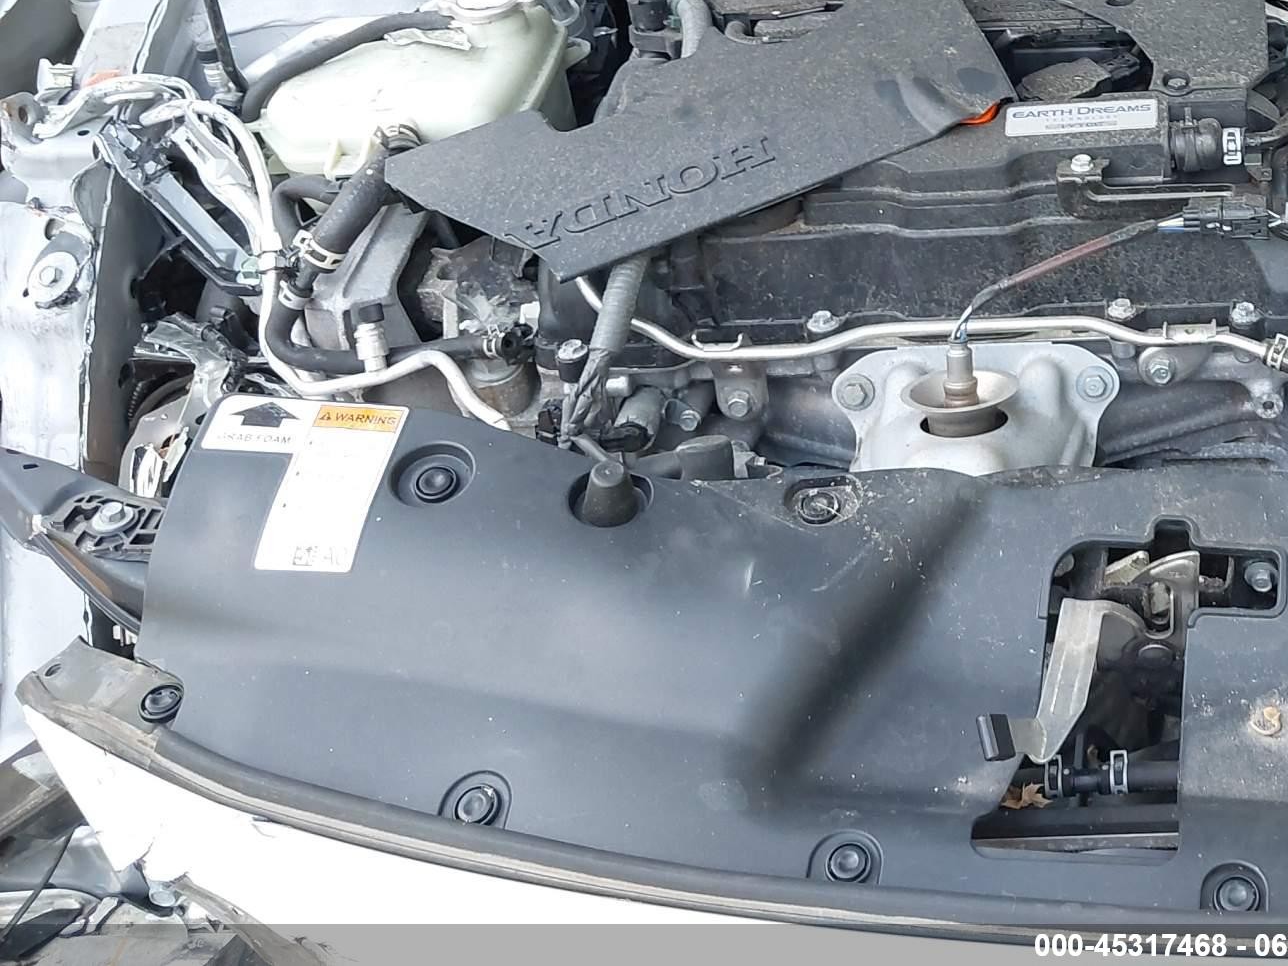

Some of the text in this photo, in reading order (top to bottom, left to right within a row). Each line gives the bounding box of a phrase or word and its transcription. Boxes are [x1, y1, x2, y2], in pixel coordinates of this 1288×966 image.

[1012, 108, 1072, 119] EARTH
[1078, 104, 1151, 115] DREAMS
[503, 136, 777, 250] HONDA
[335, 412, 397, 426] WARNING
